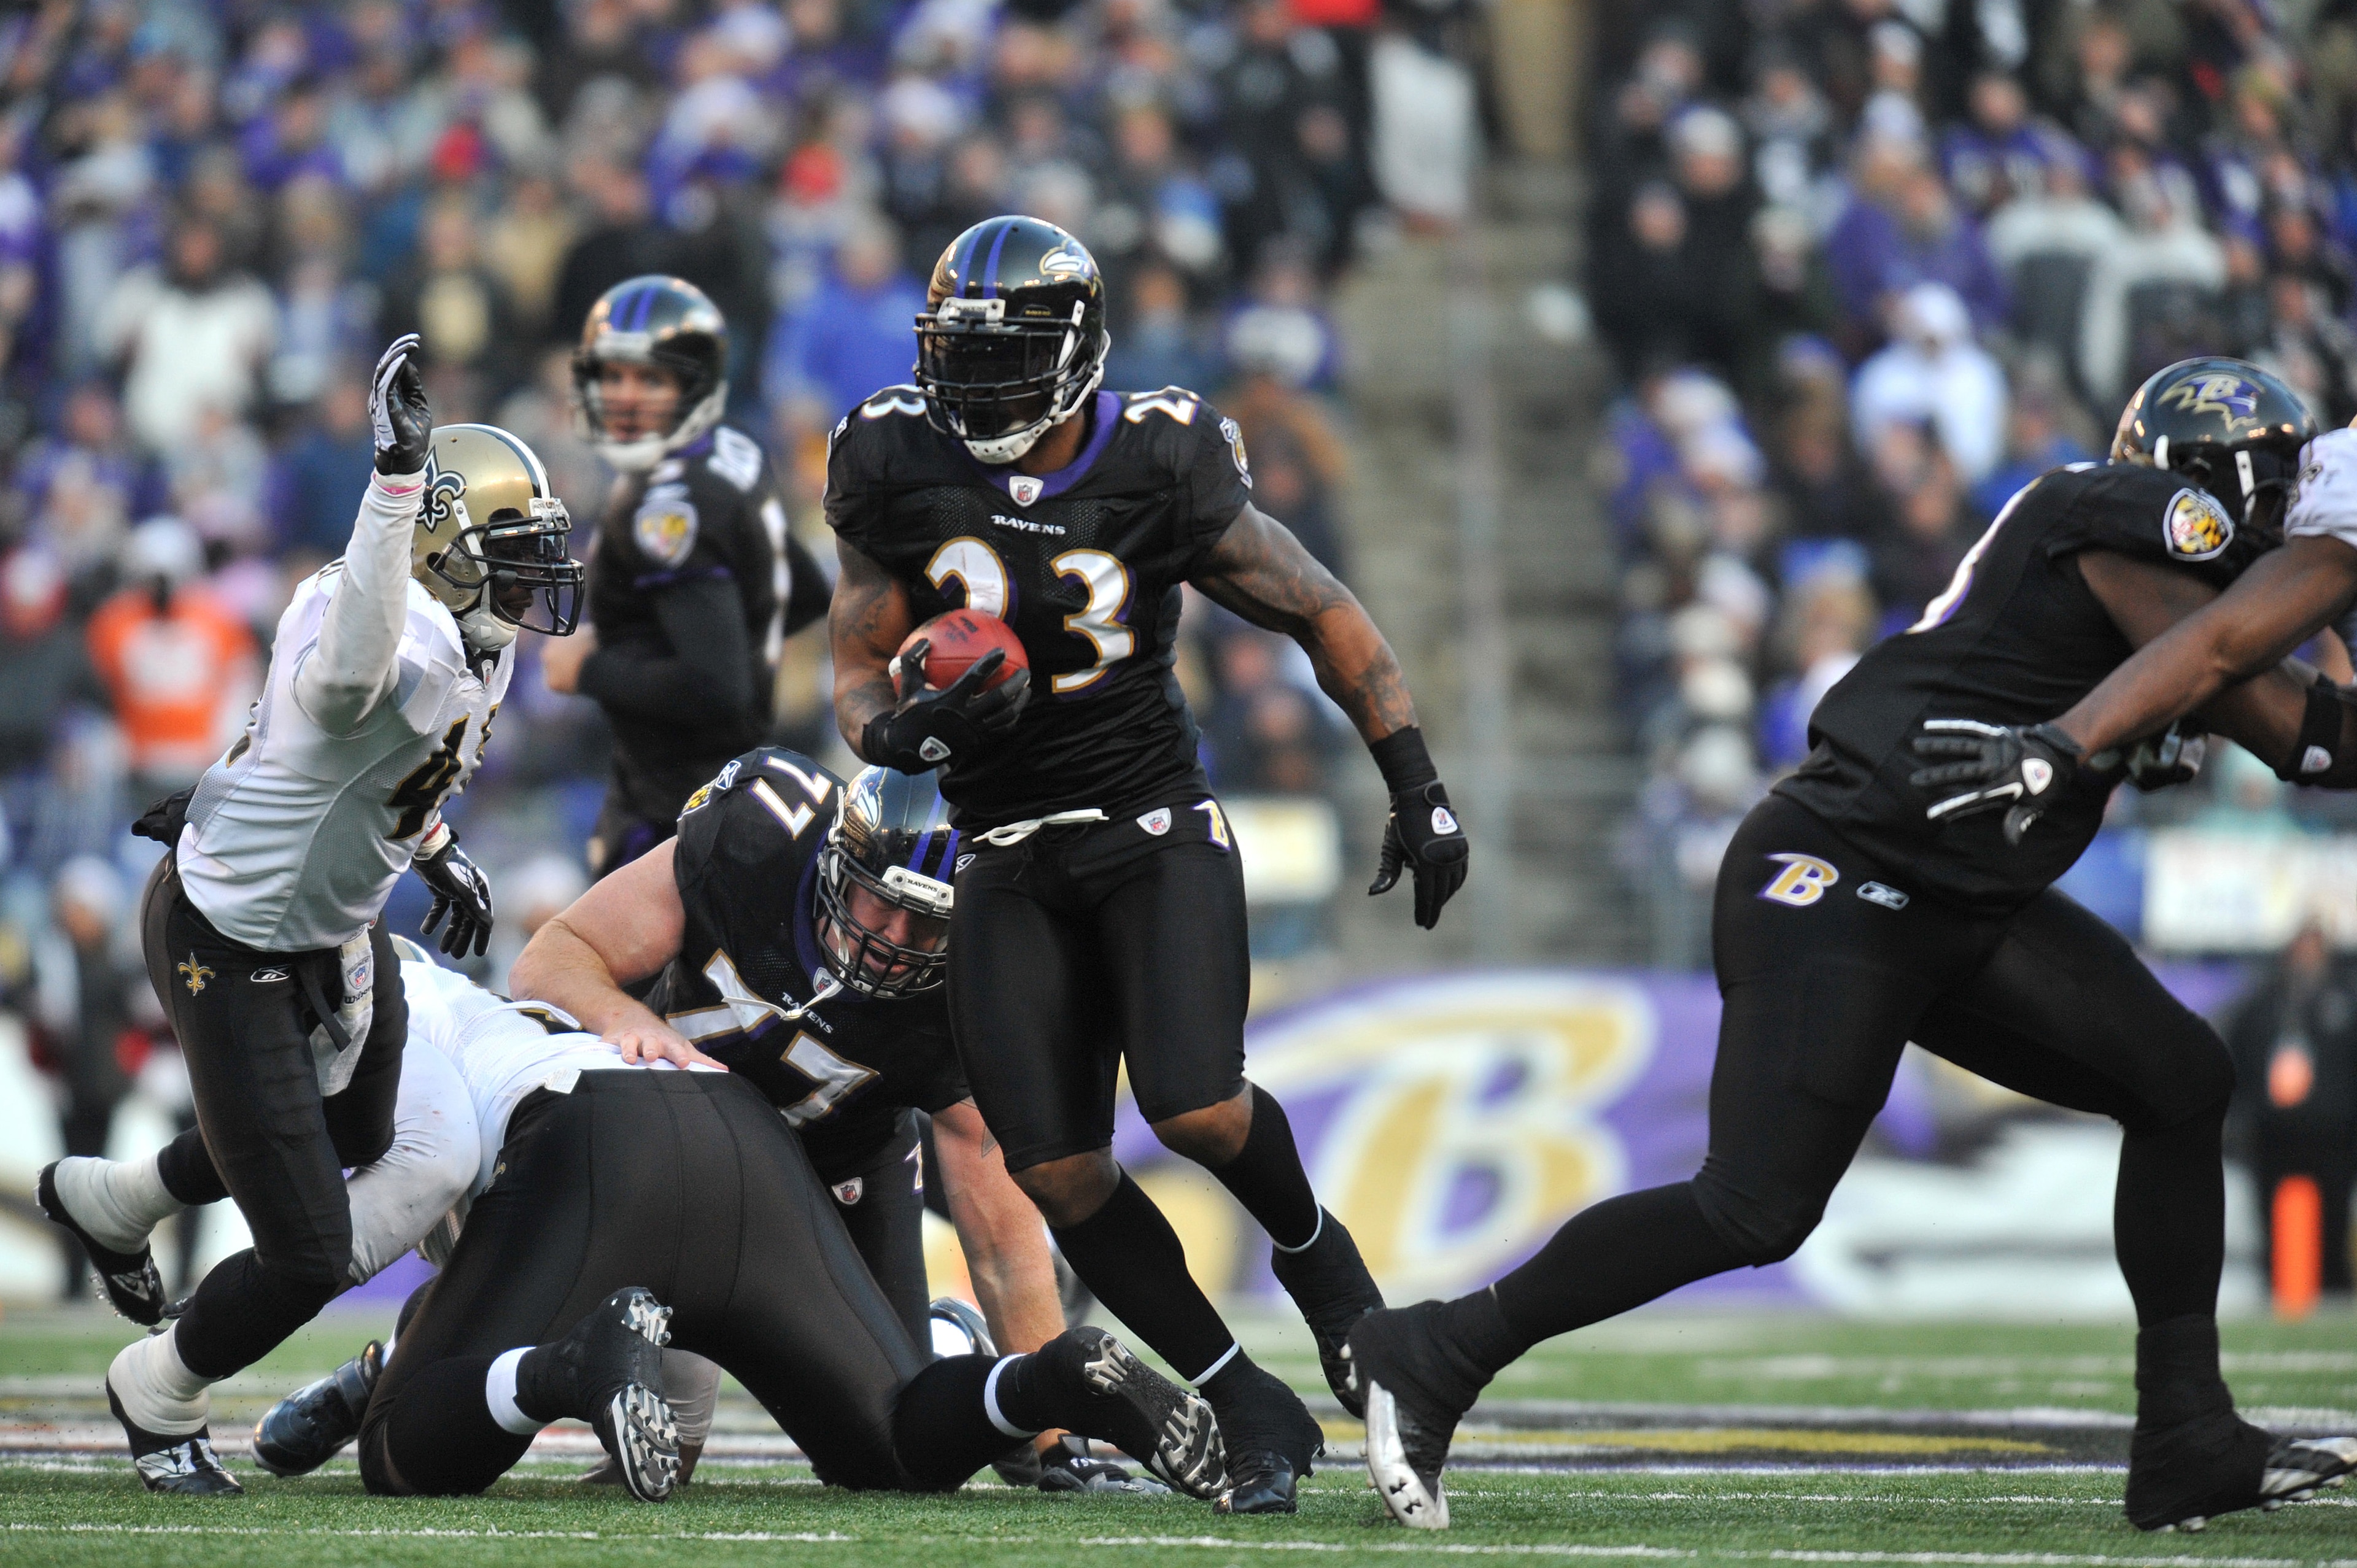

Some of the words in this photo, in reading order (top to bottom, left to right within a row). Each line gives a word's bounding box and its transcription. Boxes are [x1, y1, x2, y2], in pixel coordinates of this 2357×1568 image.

[990, 514, 1067, 535] RAVENS
[750, 755, 833, 841] 77
[906, 878, 939, 892] RAVENS
[1760, 852, 1840, 907] B
